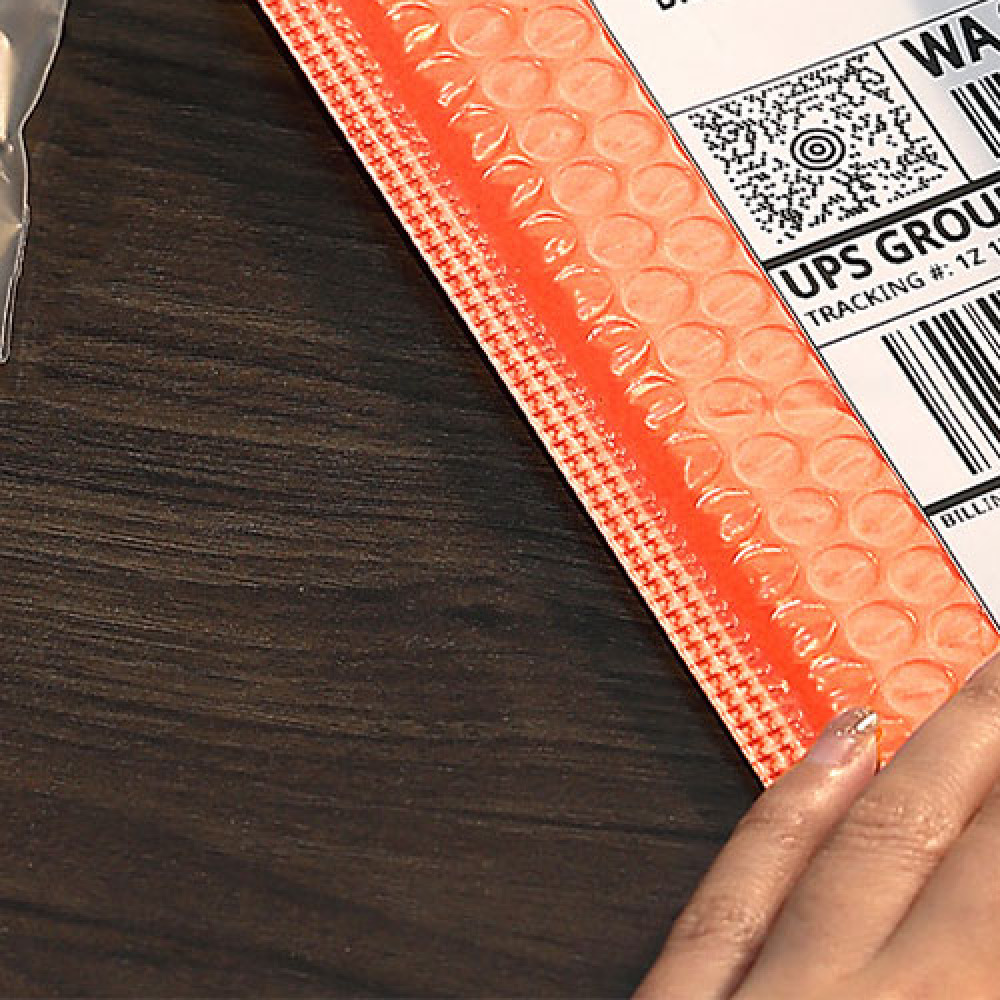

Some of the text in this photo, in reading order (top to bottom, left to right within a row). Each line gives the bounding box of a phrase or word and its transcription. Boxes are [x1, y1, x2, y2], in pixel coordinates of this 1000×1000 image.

[779, 244, 873, 299] UPS
[805, 272, 925, 327] TRACKING
[929, 263, 955, 281] #:
[955, 247, 987, 269] 1Z
